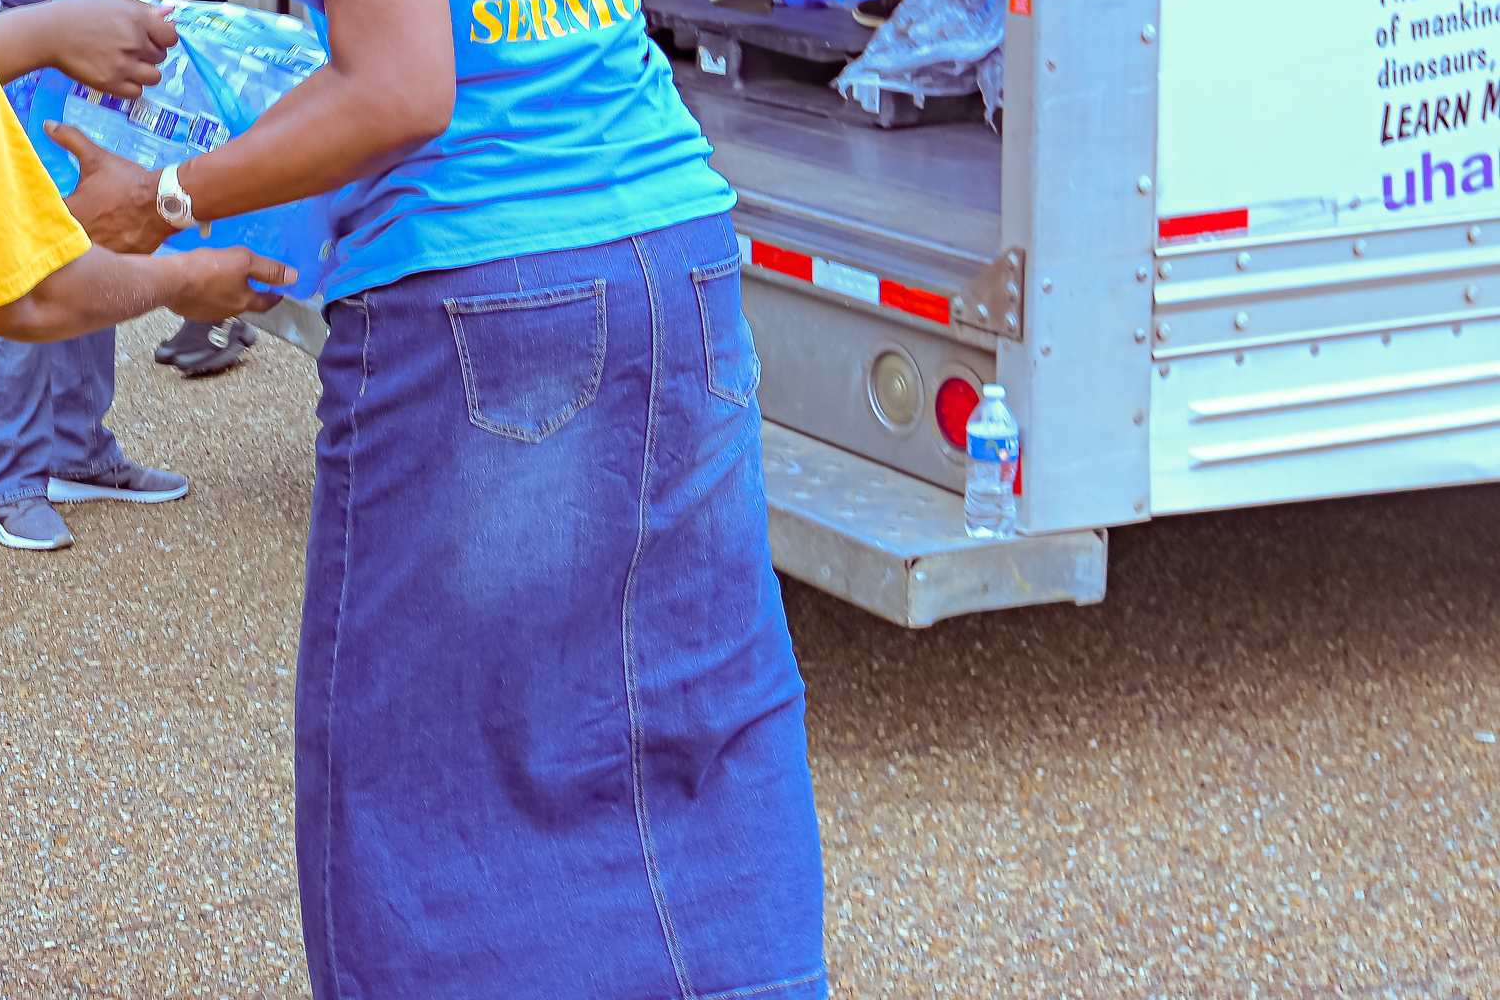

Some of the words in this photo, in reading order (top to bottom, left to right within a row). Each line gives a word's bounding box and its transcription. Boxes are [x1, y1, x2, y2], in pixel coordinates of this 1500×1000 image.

[1376, 12, 1401, 49] of
[1377, 46, 1496, 89] dinosaurs,
[1380, 89, 1472, 146] LEARN
[1381, 147, 1500, 212] uha
